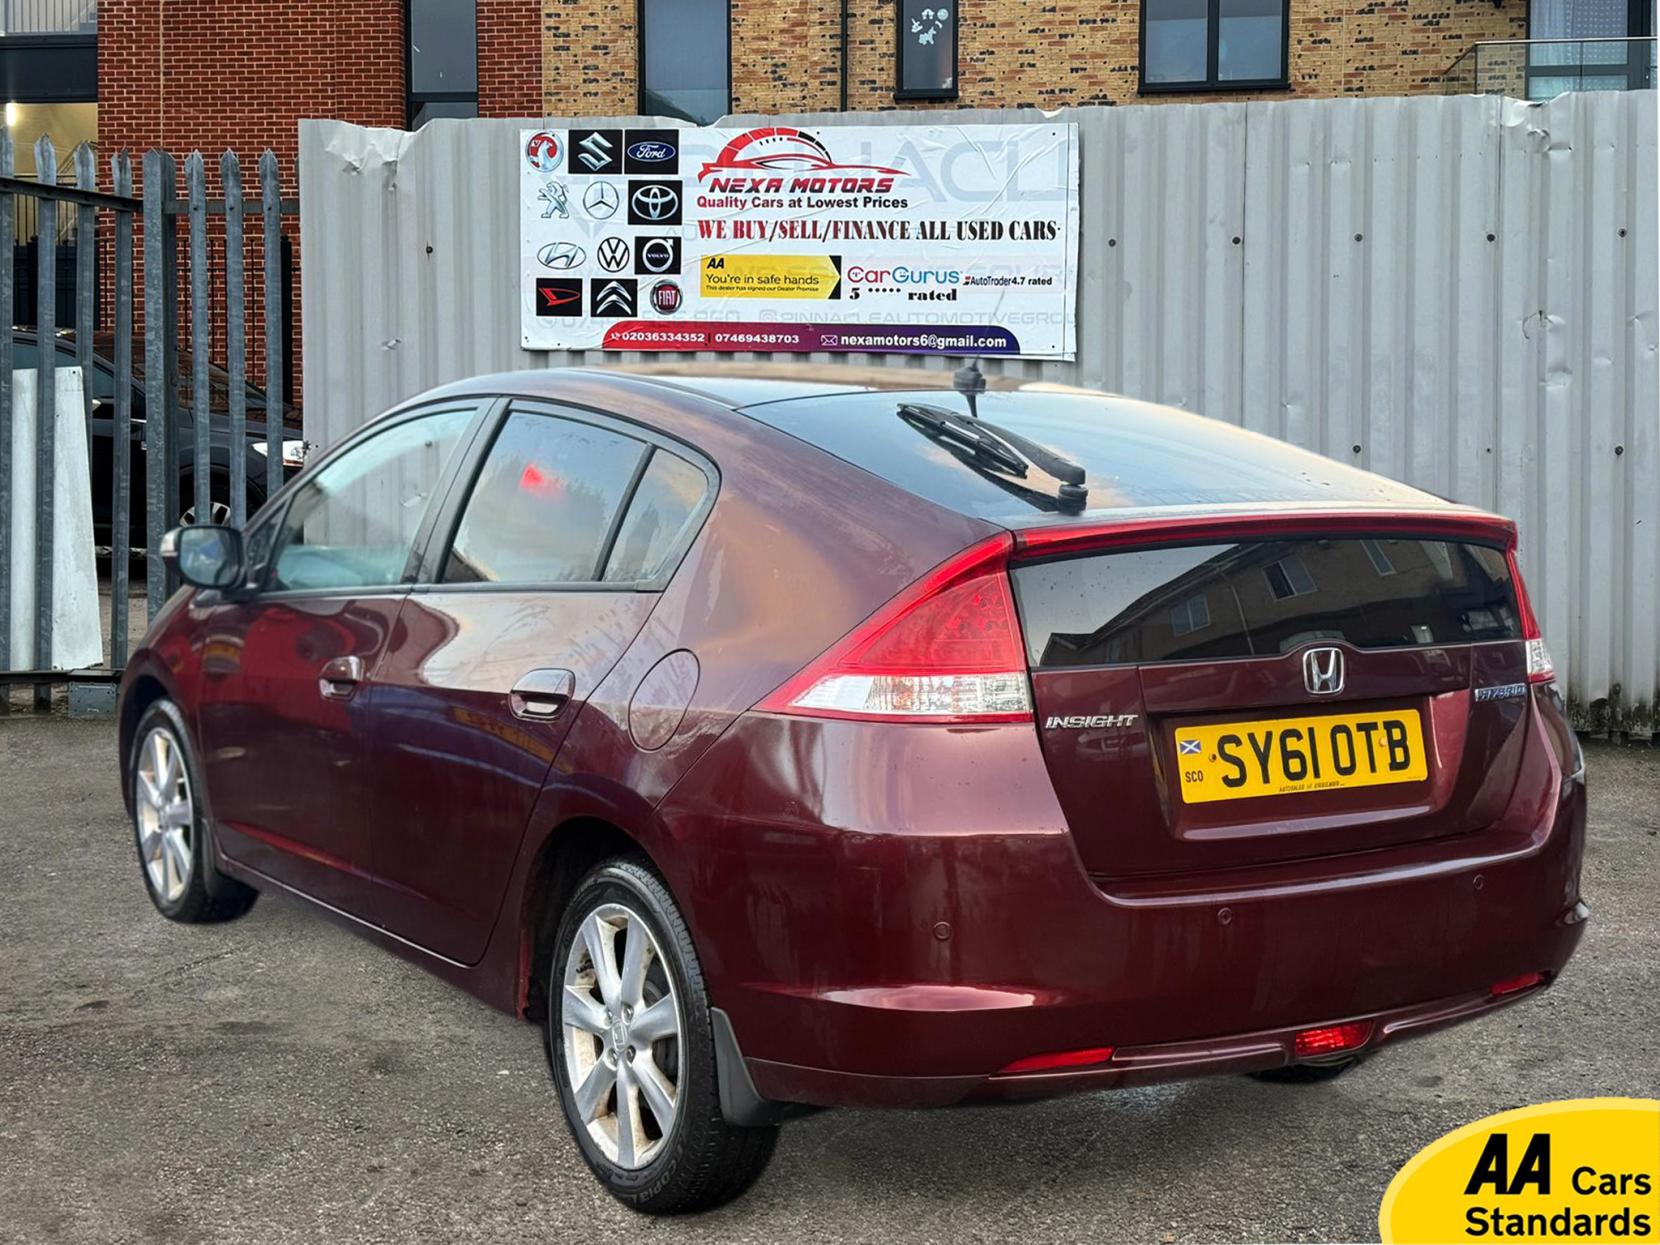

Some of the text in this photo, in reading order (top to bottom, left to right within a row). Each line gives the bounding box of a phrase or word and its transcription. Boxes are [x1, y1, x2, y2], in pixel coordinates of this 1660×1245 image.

[636, 144, 666, 159] Ford
[708, 177, 894, 193] NEXA MOTORS
[697, 195, 908, 210] Quality Cars at Lowest Prices
[697, 219, 726, 240] WE
[916, 220, 950, 240] ALL
[956, 220, 1003, 241] USED
[1009, 220, 1056, 241] CARS
[706, 257, 724, 269] AA
[706, 273, 819, 285] You're in safe hands
[847, 265, 960, 284] CarGurus
[1028, 277, 1053, 286] rated
[658, 290, 676, 305] FIAT
[849, 287, 957, 301] 5 rated
[622, 331, 800, 344] 02036334352 07469438703
[841, 334, 1007, 349] nexamotors6@gmail.com
[1045, 714, 1139, 729] INSIGHT
[1217, 720, 1411, 788] SY61 OTB
[1185, 770, 1204, 783] SCO
